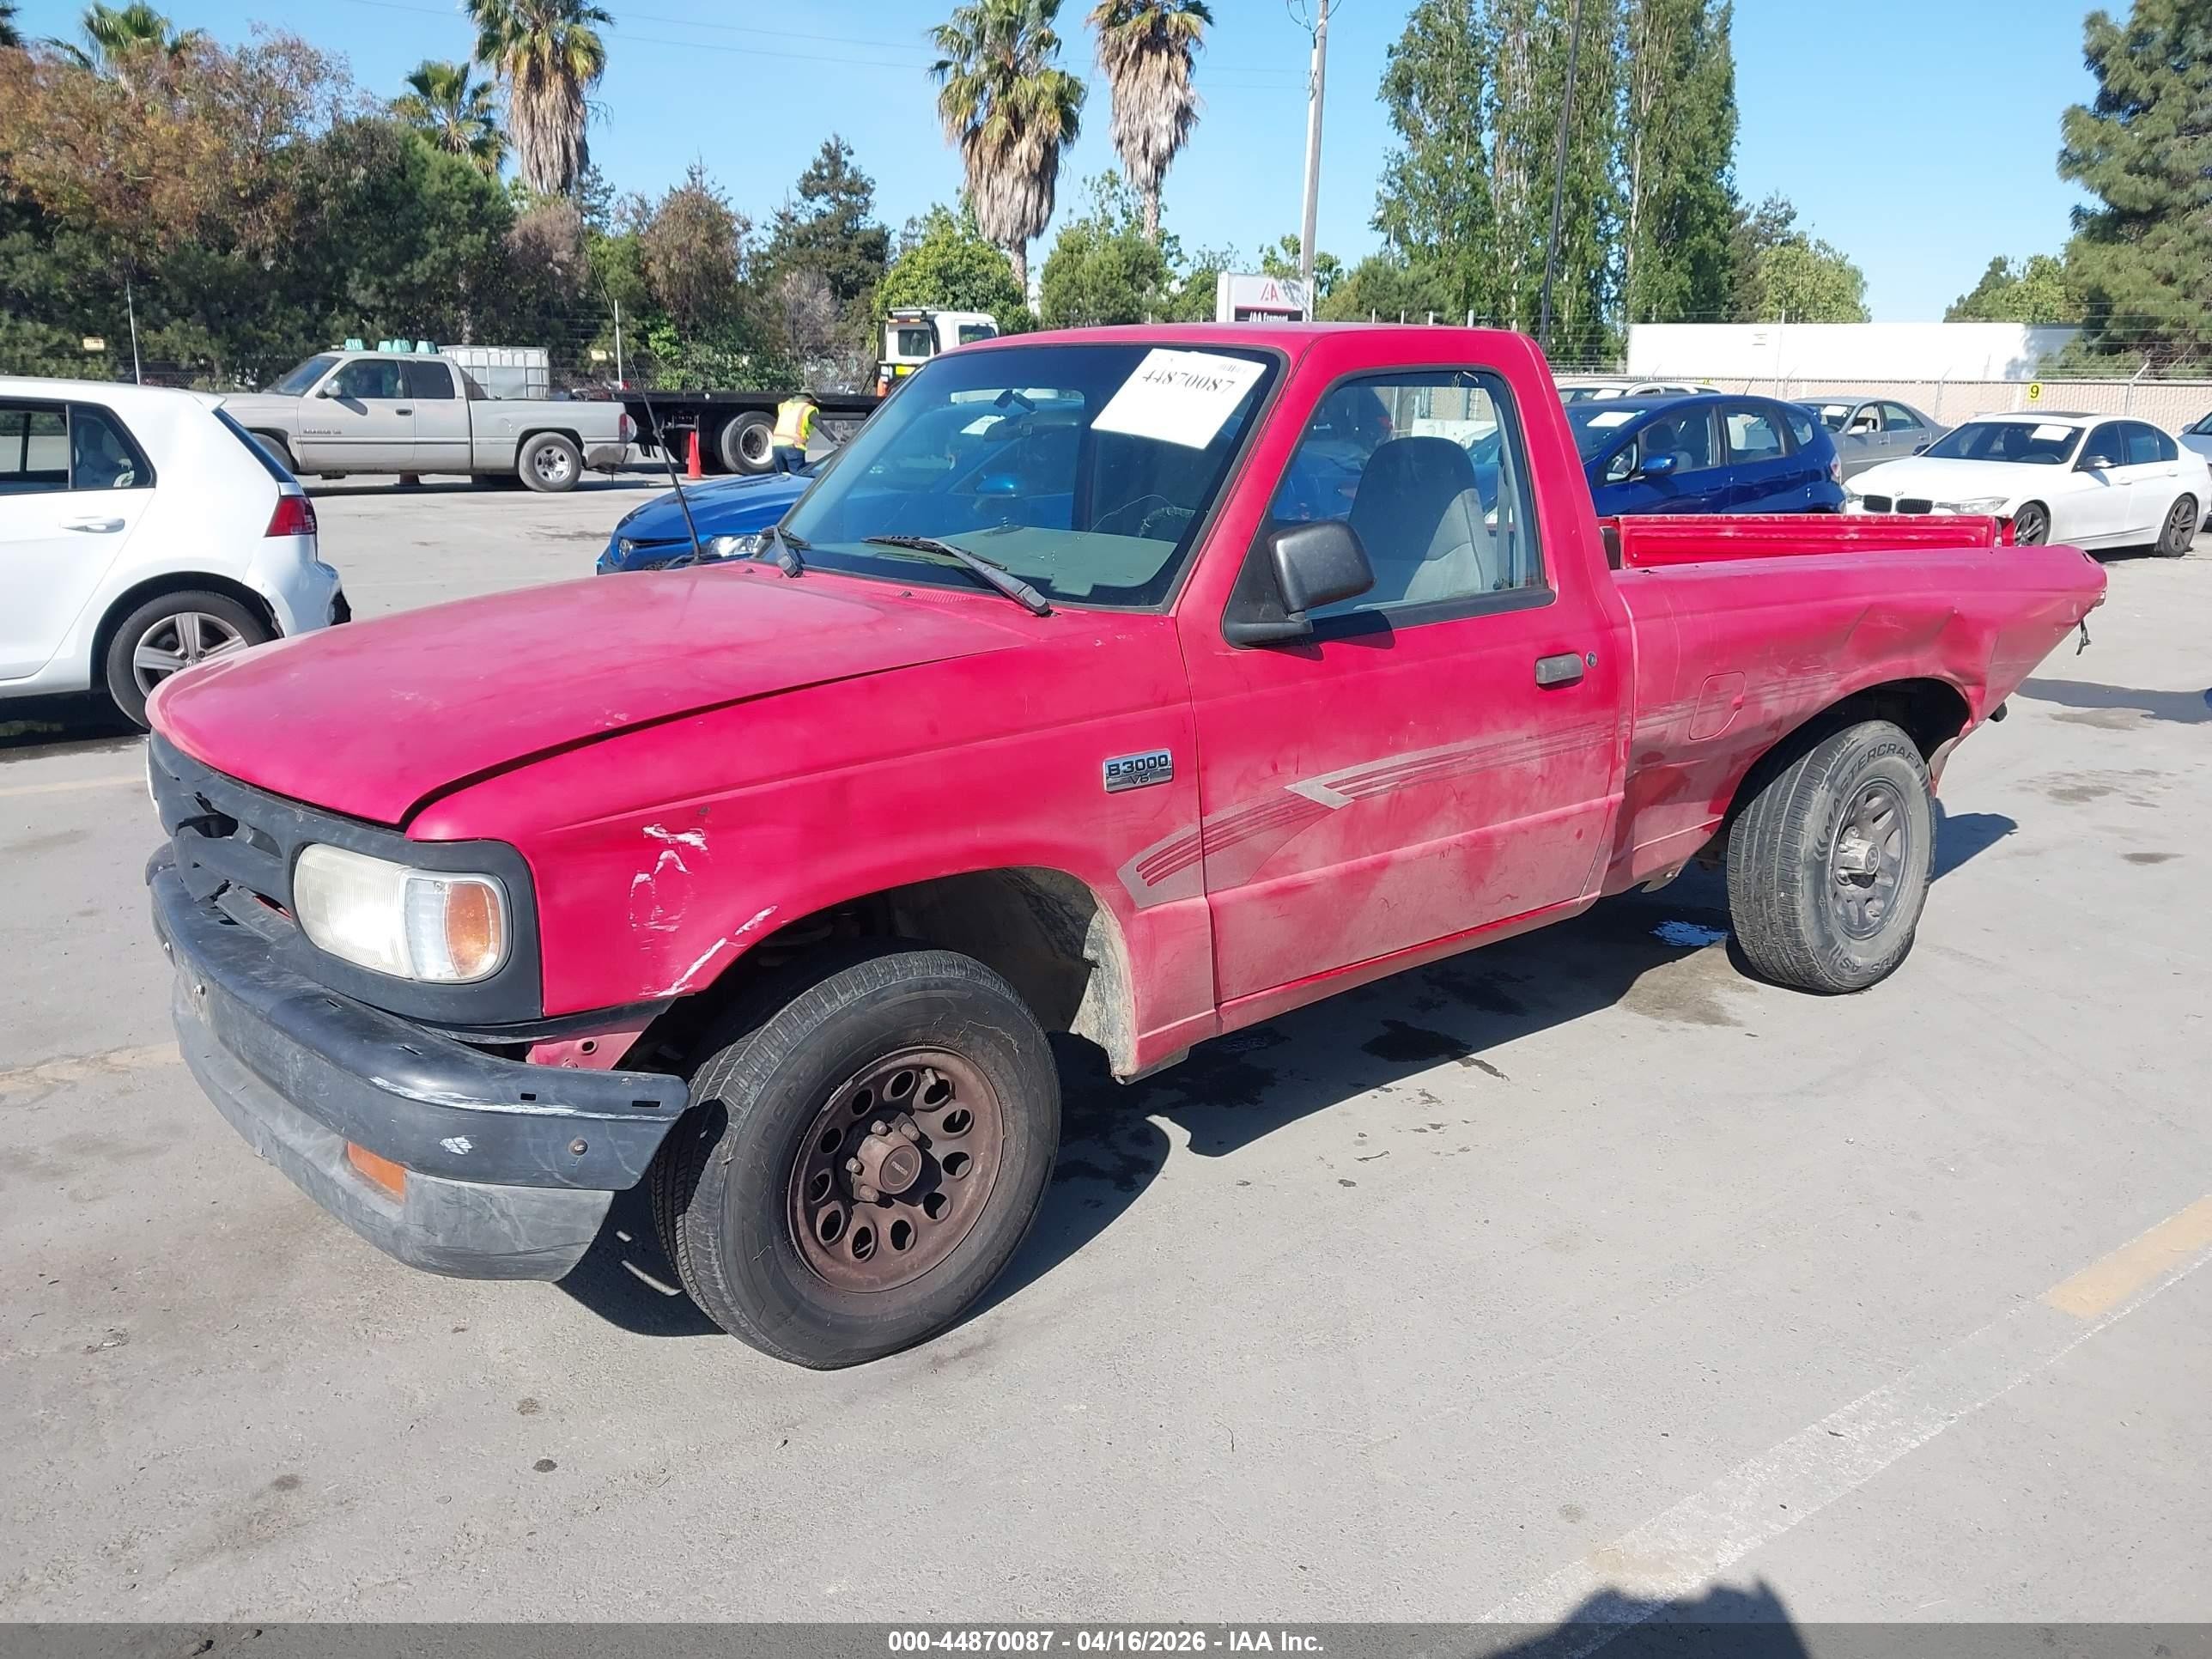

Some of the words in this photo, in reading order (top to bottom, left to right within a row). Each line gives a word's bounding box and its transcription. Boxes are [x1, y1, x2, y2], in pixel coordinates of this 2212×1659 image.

[1142, 369, 1236, 394] 44870087
[2030, 385, 2039, 398] 9
[1108, 754, 1169, 776] B3000
[1129, 773, 1150, 785] V6
[1825, 743, 1924, 839] MASTERCRAFT
